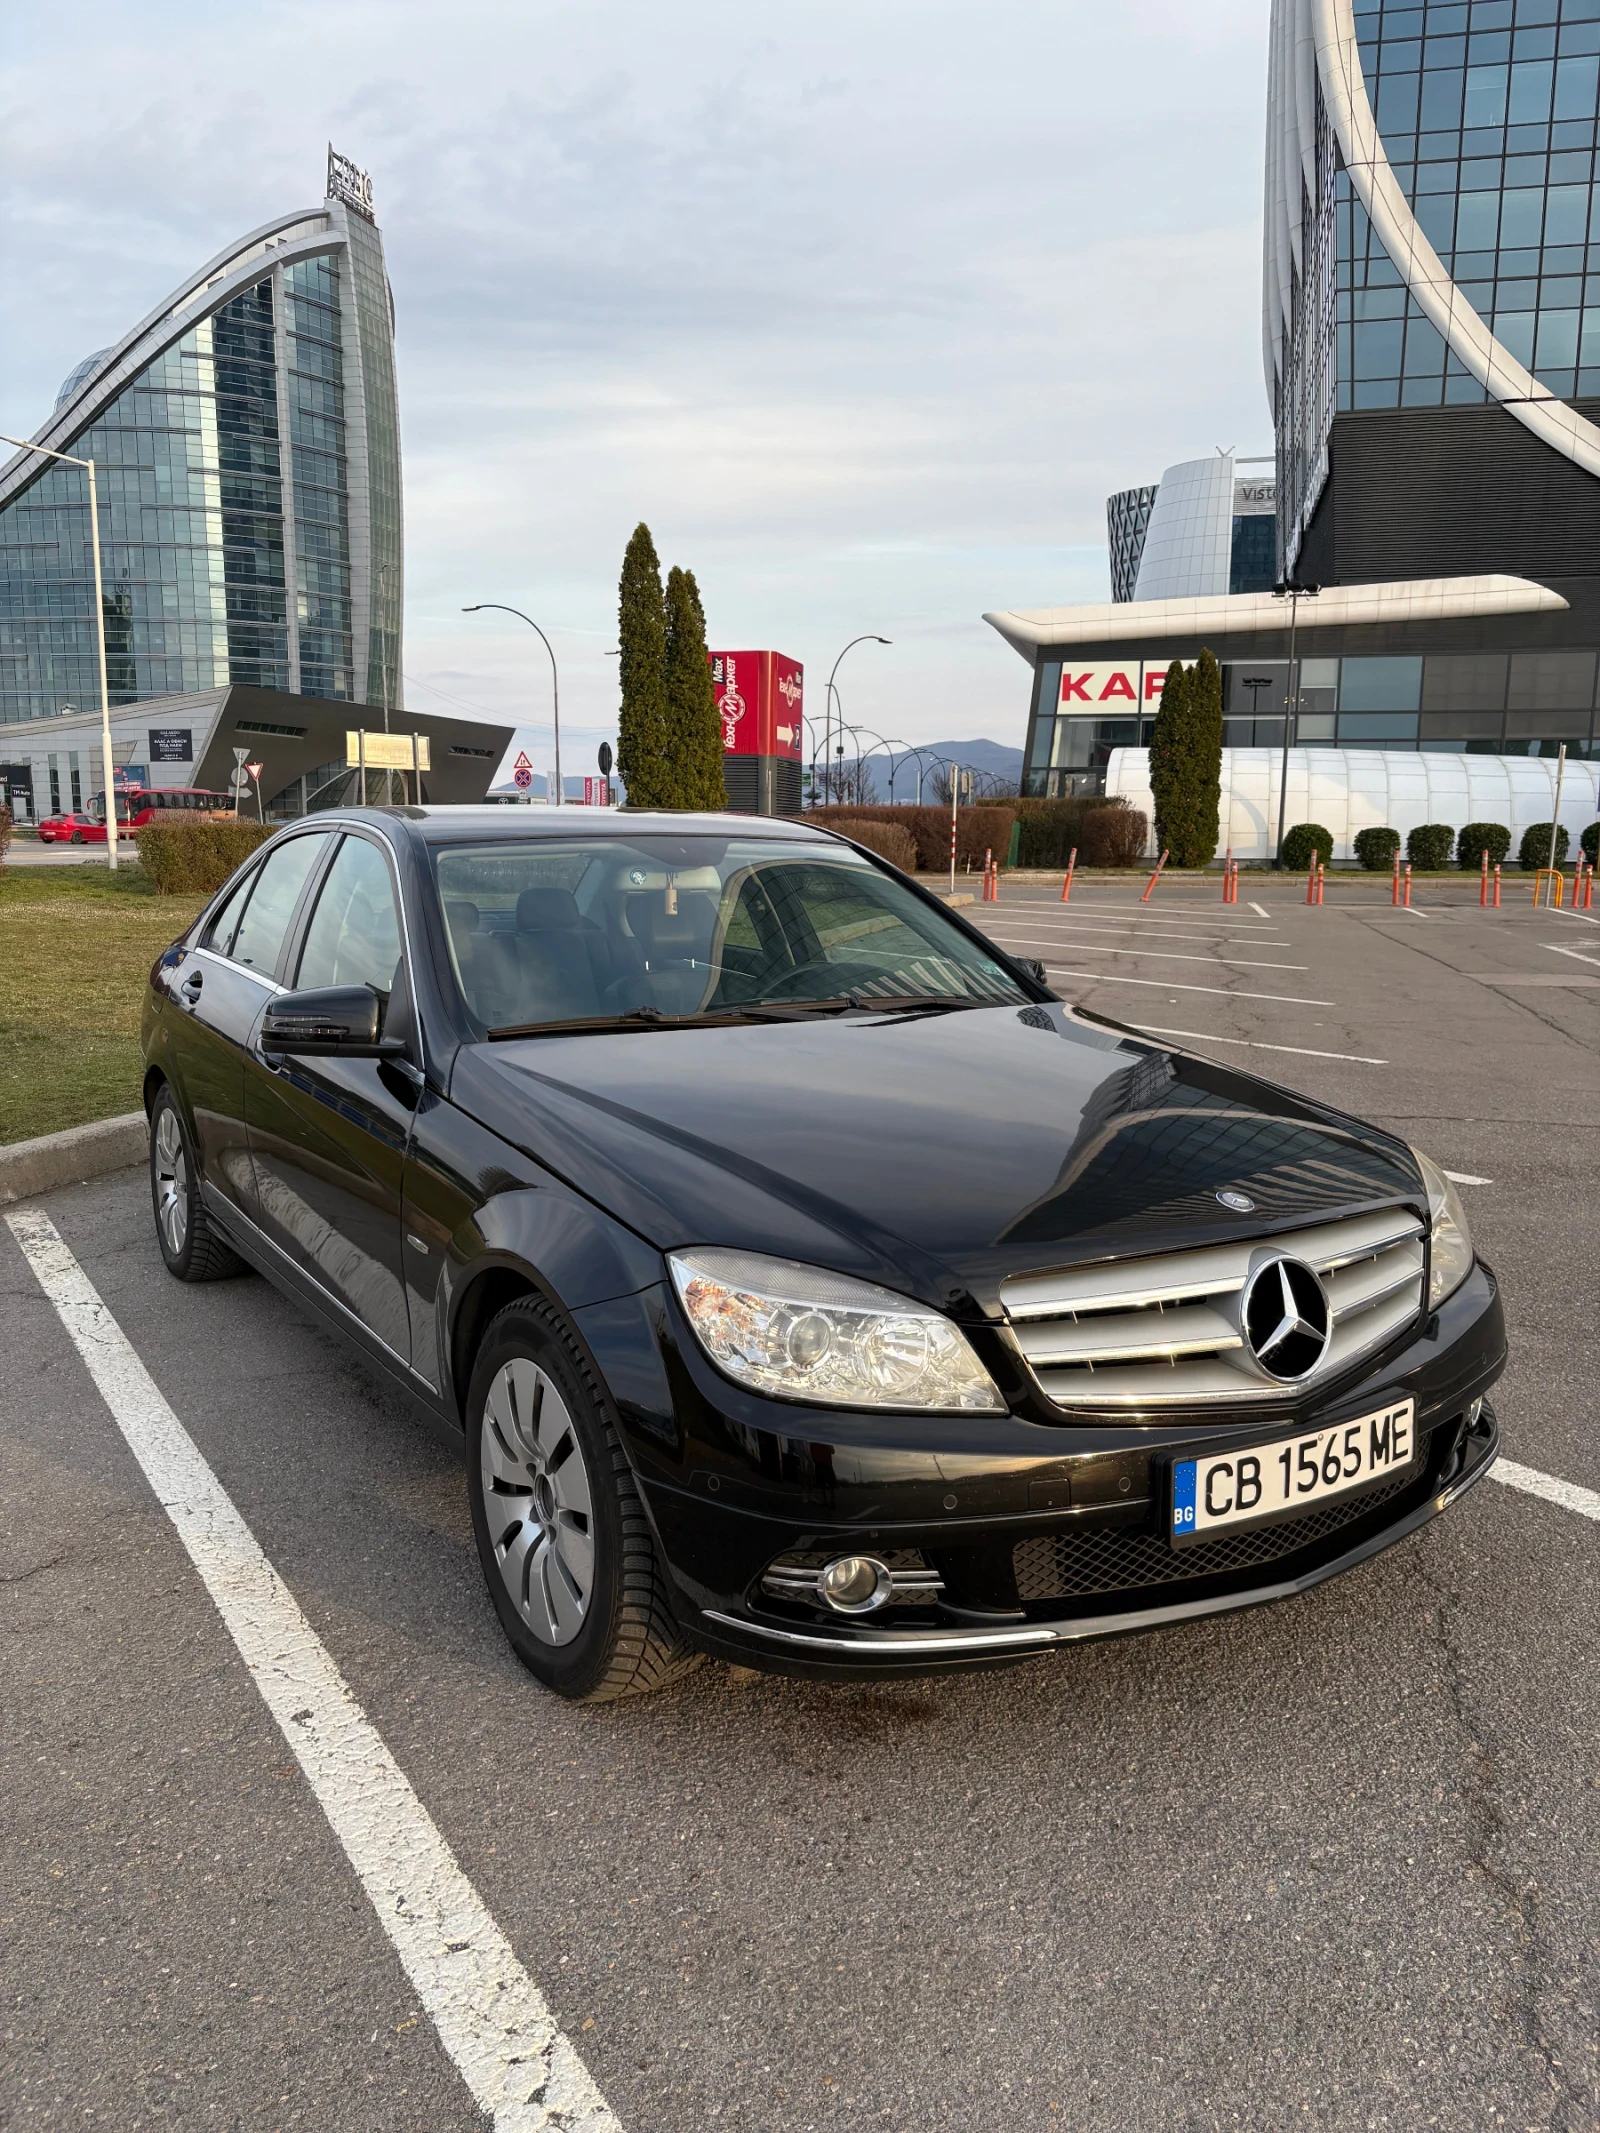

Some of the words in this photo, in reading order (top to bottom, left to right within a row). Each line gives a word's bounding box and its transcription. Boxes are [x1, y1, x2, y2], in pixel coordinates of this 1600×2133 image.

[713, 658, 724, 682] Max
[1205, 1456, 1262, 1516] CB
[1279, 1426, 1361, 1498] 1565
[1369, 1408, 1409, 1470] ME
[1174, 1507, 1194, 1525] BG
